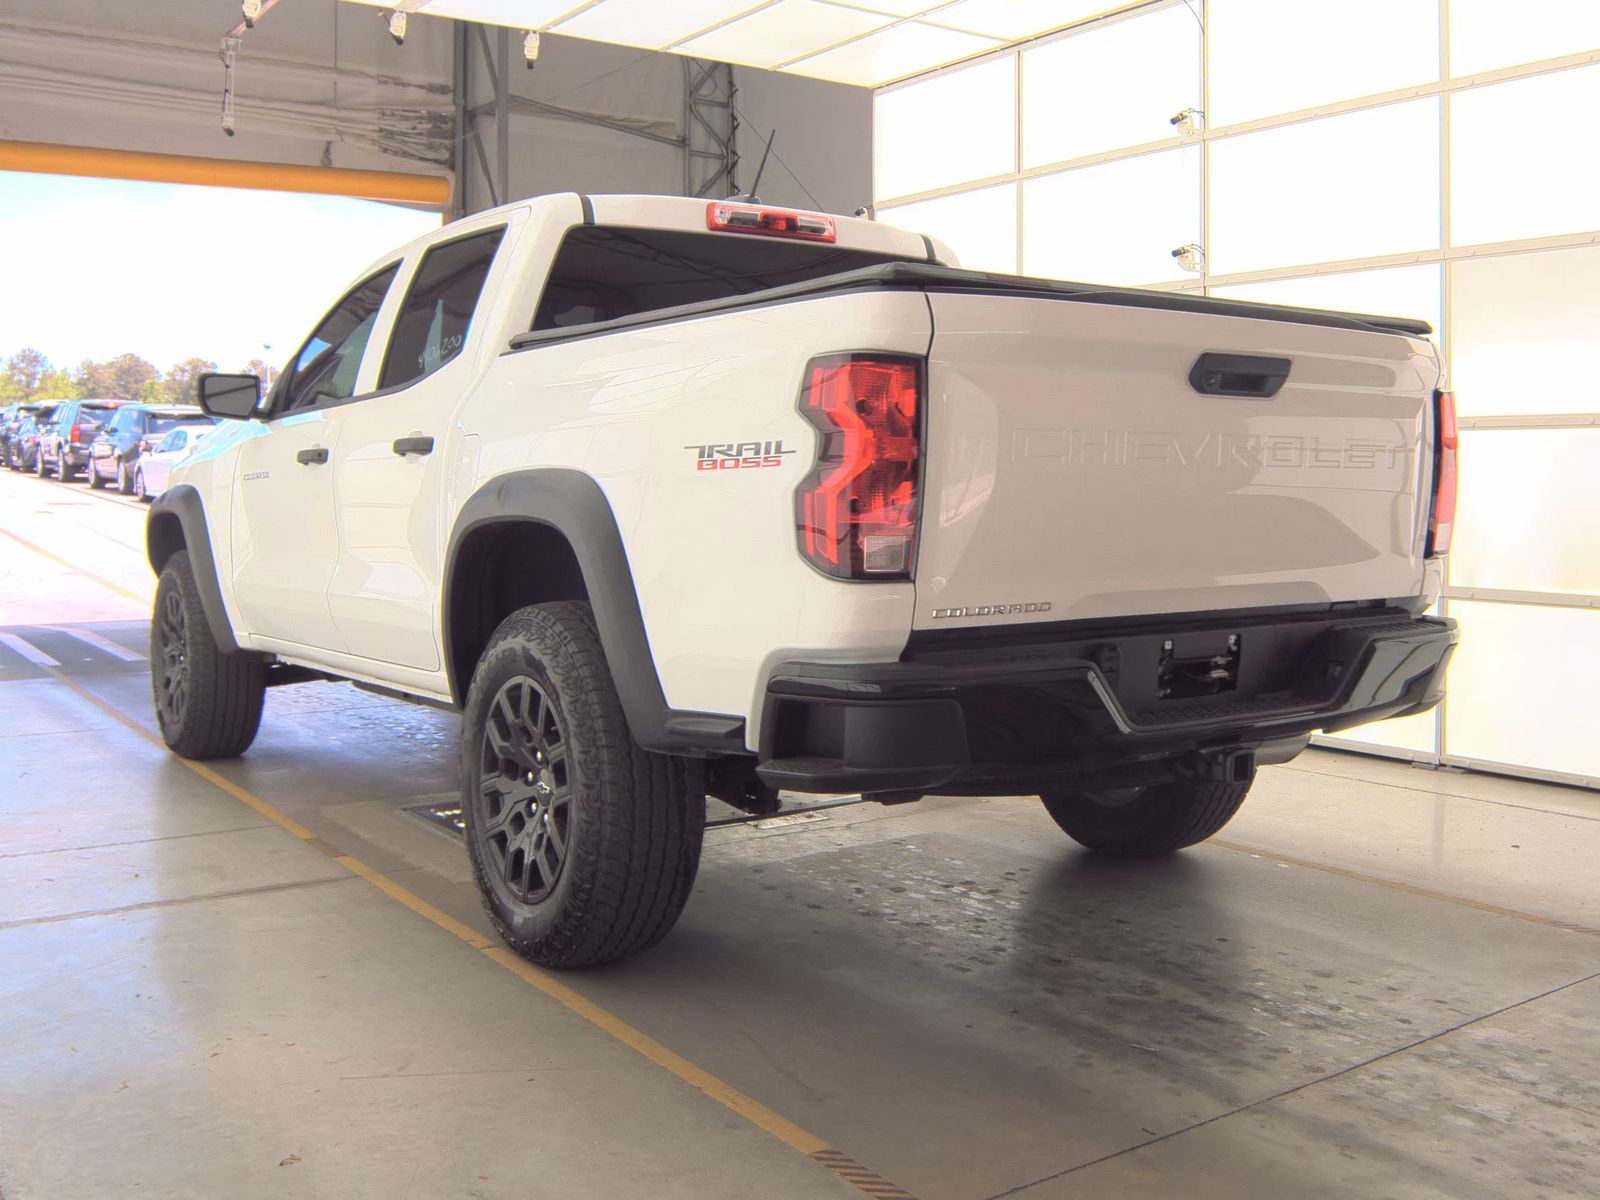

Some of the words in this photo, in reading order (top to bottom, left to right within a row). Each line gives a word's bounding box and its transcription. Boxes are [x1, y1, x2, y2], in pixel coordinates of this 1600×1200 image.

[684, 440, 796, 458] TRAIL
[1011, 428, 1409, 469] CHEVROLET
[697, 455, 782, 470] BOSS
[932, 602, 1051, 619] COLORADO
